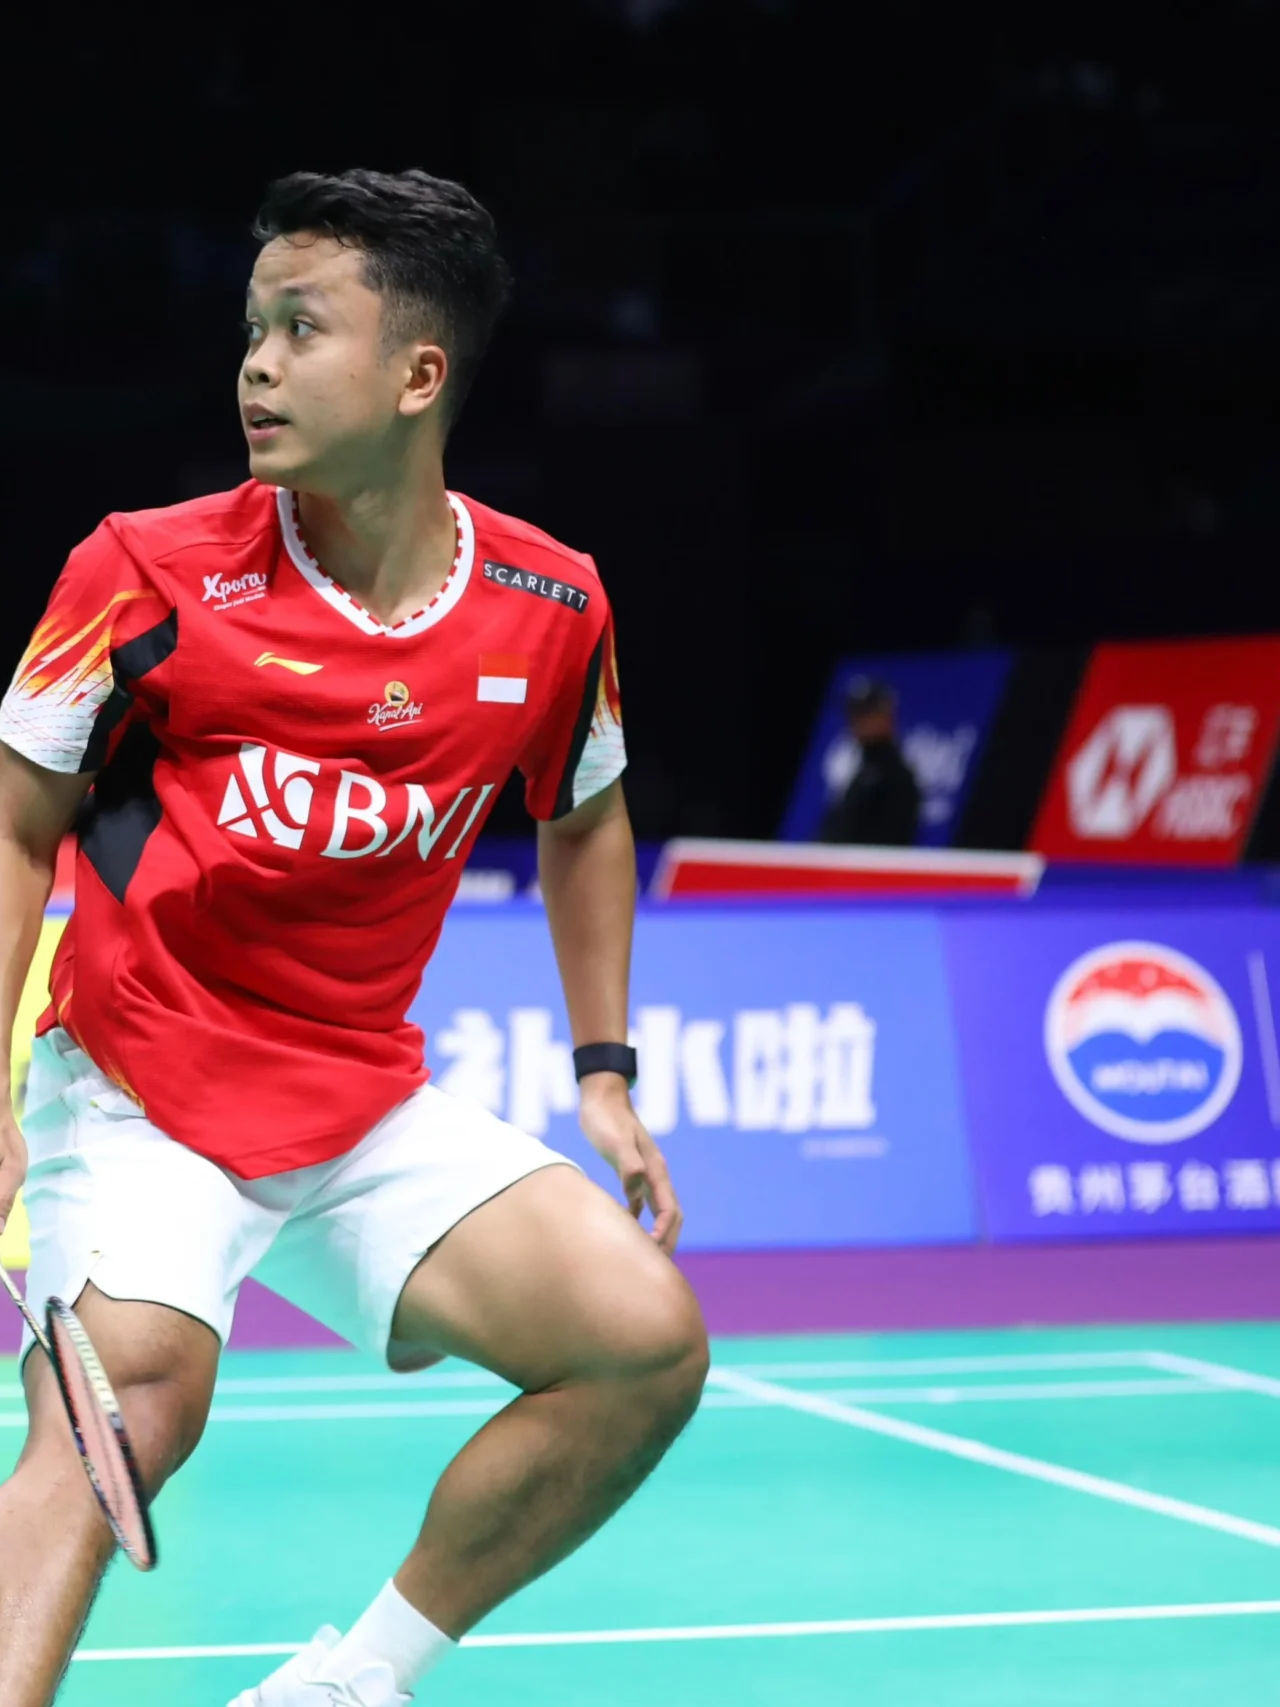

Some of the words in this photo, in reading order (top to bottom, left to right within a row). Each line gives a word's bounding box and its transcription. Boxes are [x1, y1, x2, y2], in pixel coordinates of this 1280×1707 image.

[202, 572, 267, 603] Xpora
[484, 563, 588, 609] SCARLETT
[320, 769, 495, 861] BNI
